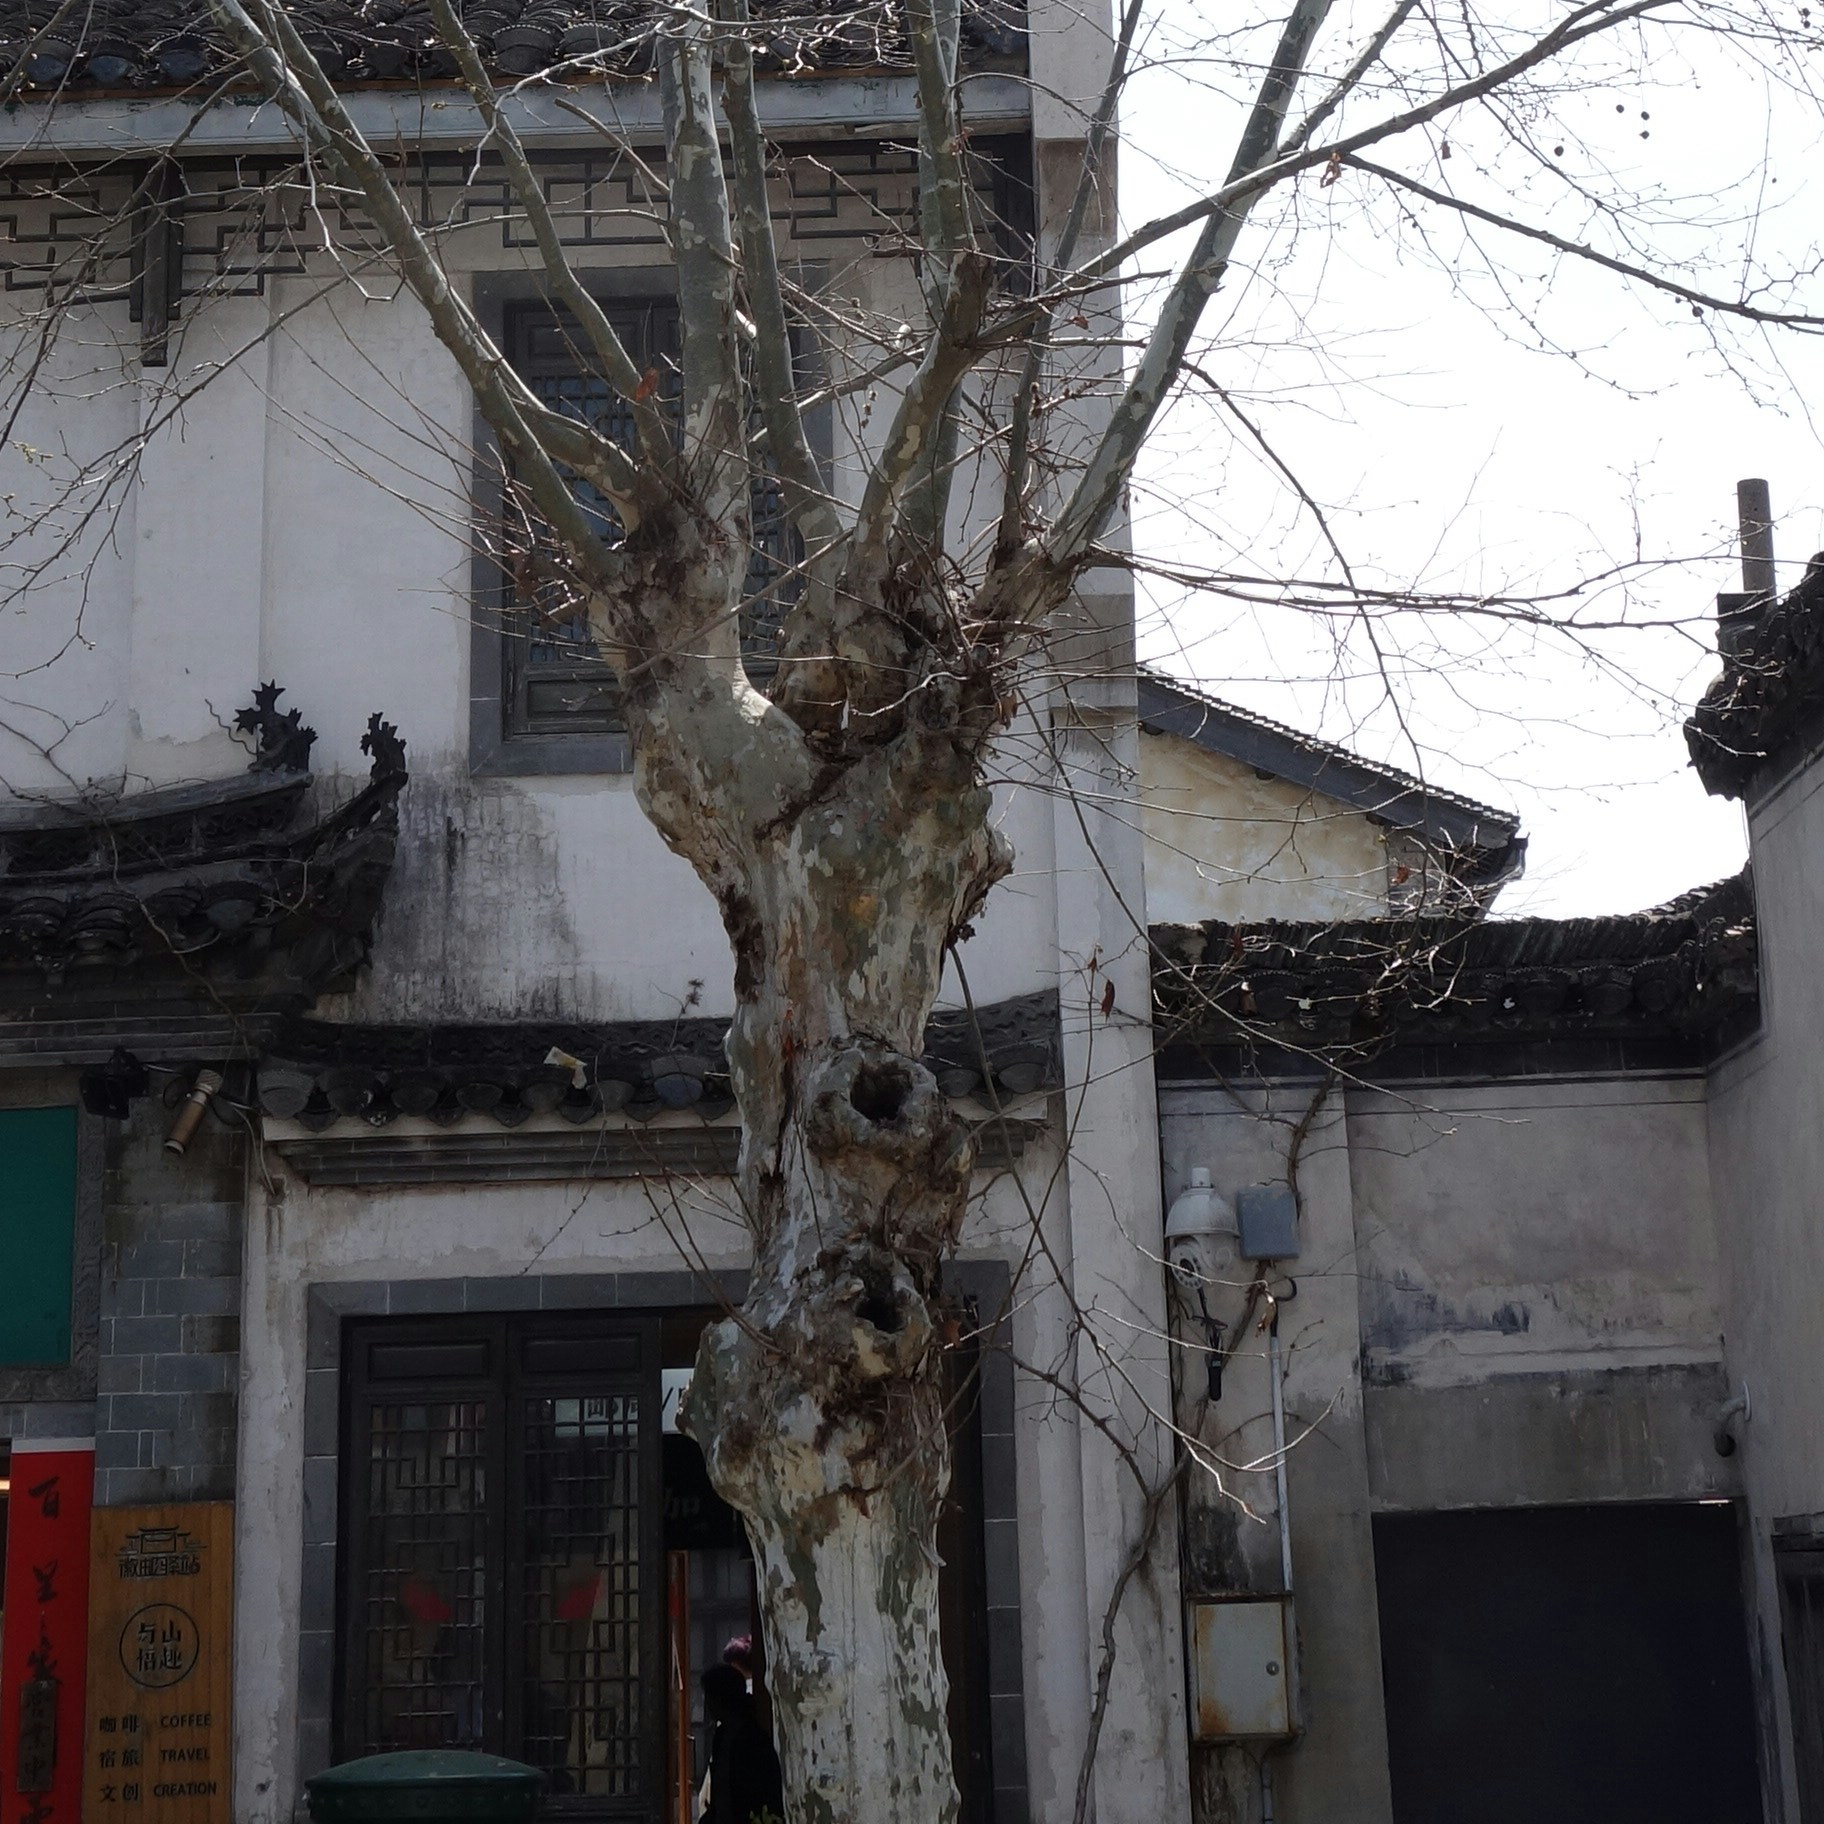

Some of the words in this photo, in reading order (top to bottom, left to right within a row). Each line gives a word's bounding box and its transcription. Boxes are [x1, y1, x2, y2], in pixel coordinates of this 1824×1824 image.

[99, 1714, 140, 1733] 咖啡
[160, 1713, 212, 1728] COFFEE
[160, 1747, 210, 1763] TRAVEL
[100, 1783, 139, 1803] 文创
[153, 1781, 217, 1798] CREATION
